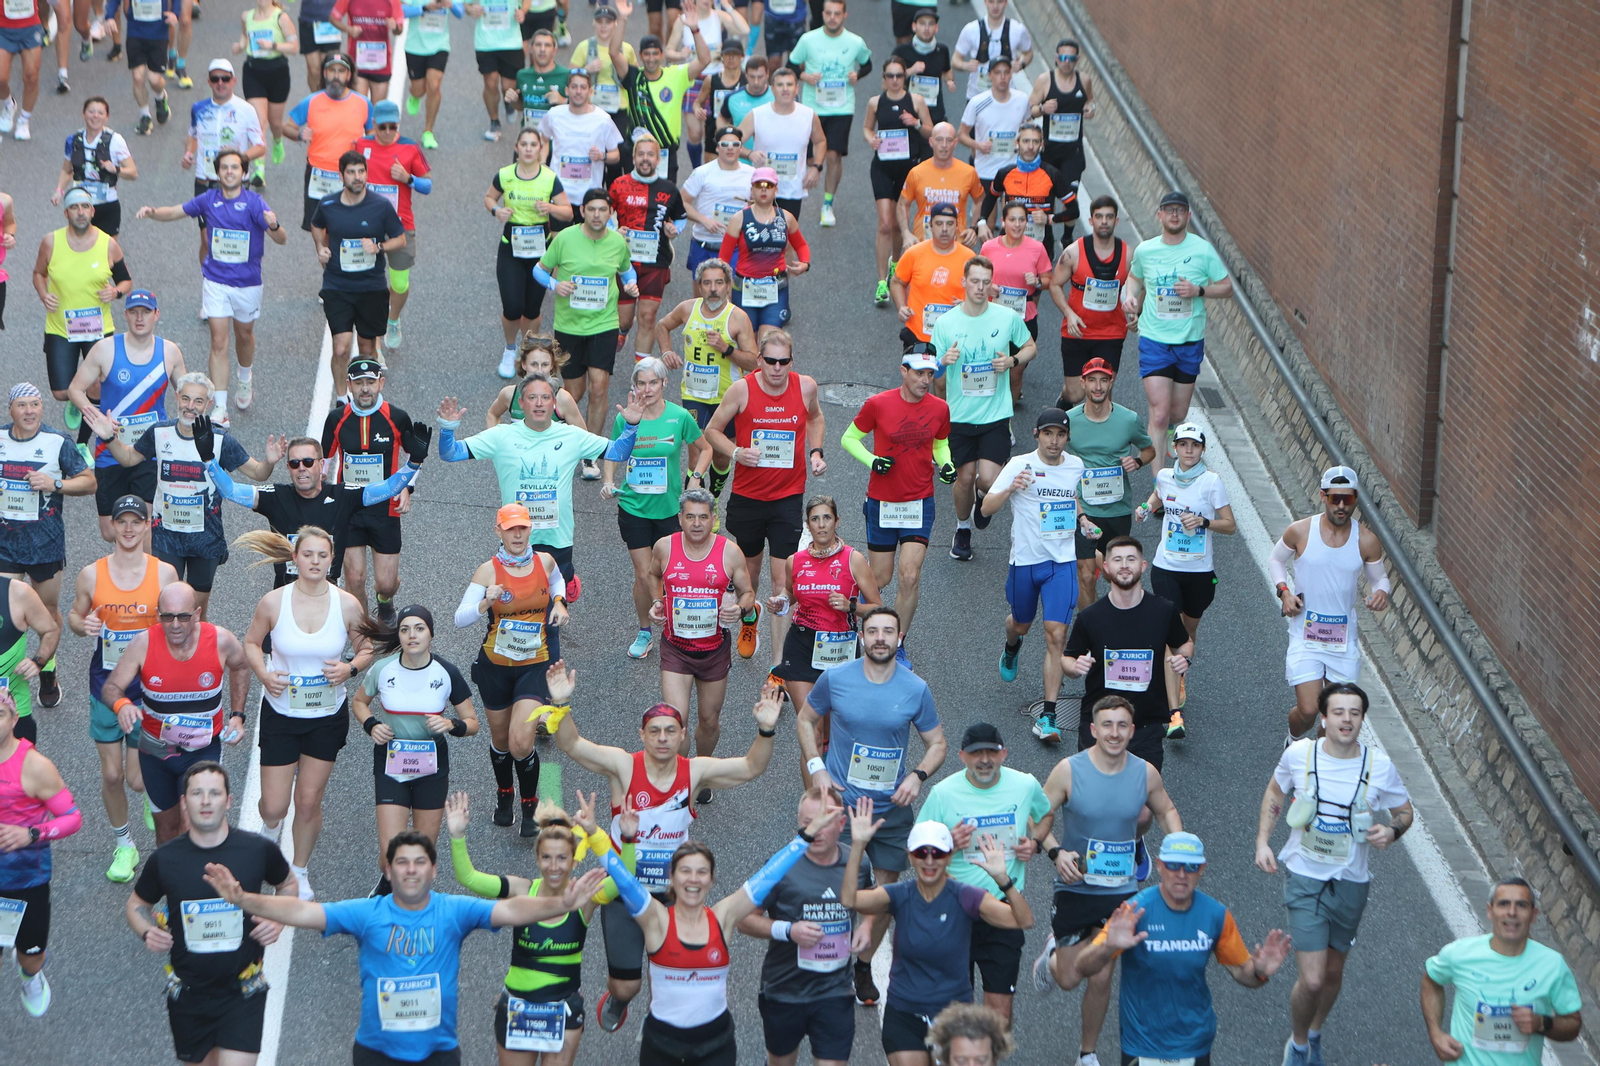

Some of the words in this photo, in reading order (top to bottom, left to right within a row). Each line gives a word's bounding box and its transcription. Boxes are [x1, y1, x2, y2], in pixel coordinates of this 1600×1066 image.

[694, 347, 701, 360] E
[130, 416, 152, 424] ZURICH
[171, 464, 201, 474] BEHOBIA
[105, 602, 147, 614] mnda
[153, 692, 209, 700] MAIDENHEAD
[182, 718, 207, 726] ZURICH
[981, 817, 1010, 825] ZURICH
[1320, 824, 1345, 832] ZURICH
[646, 850, 673, 859] ZURICH
[203, 902, 234, 911] ZURICH
[386, 924, 435, 956] RUN
[399, 979, 431, 989] ZURICH
